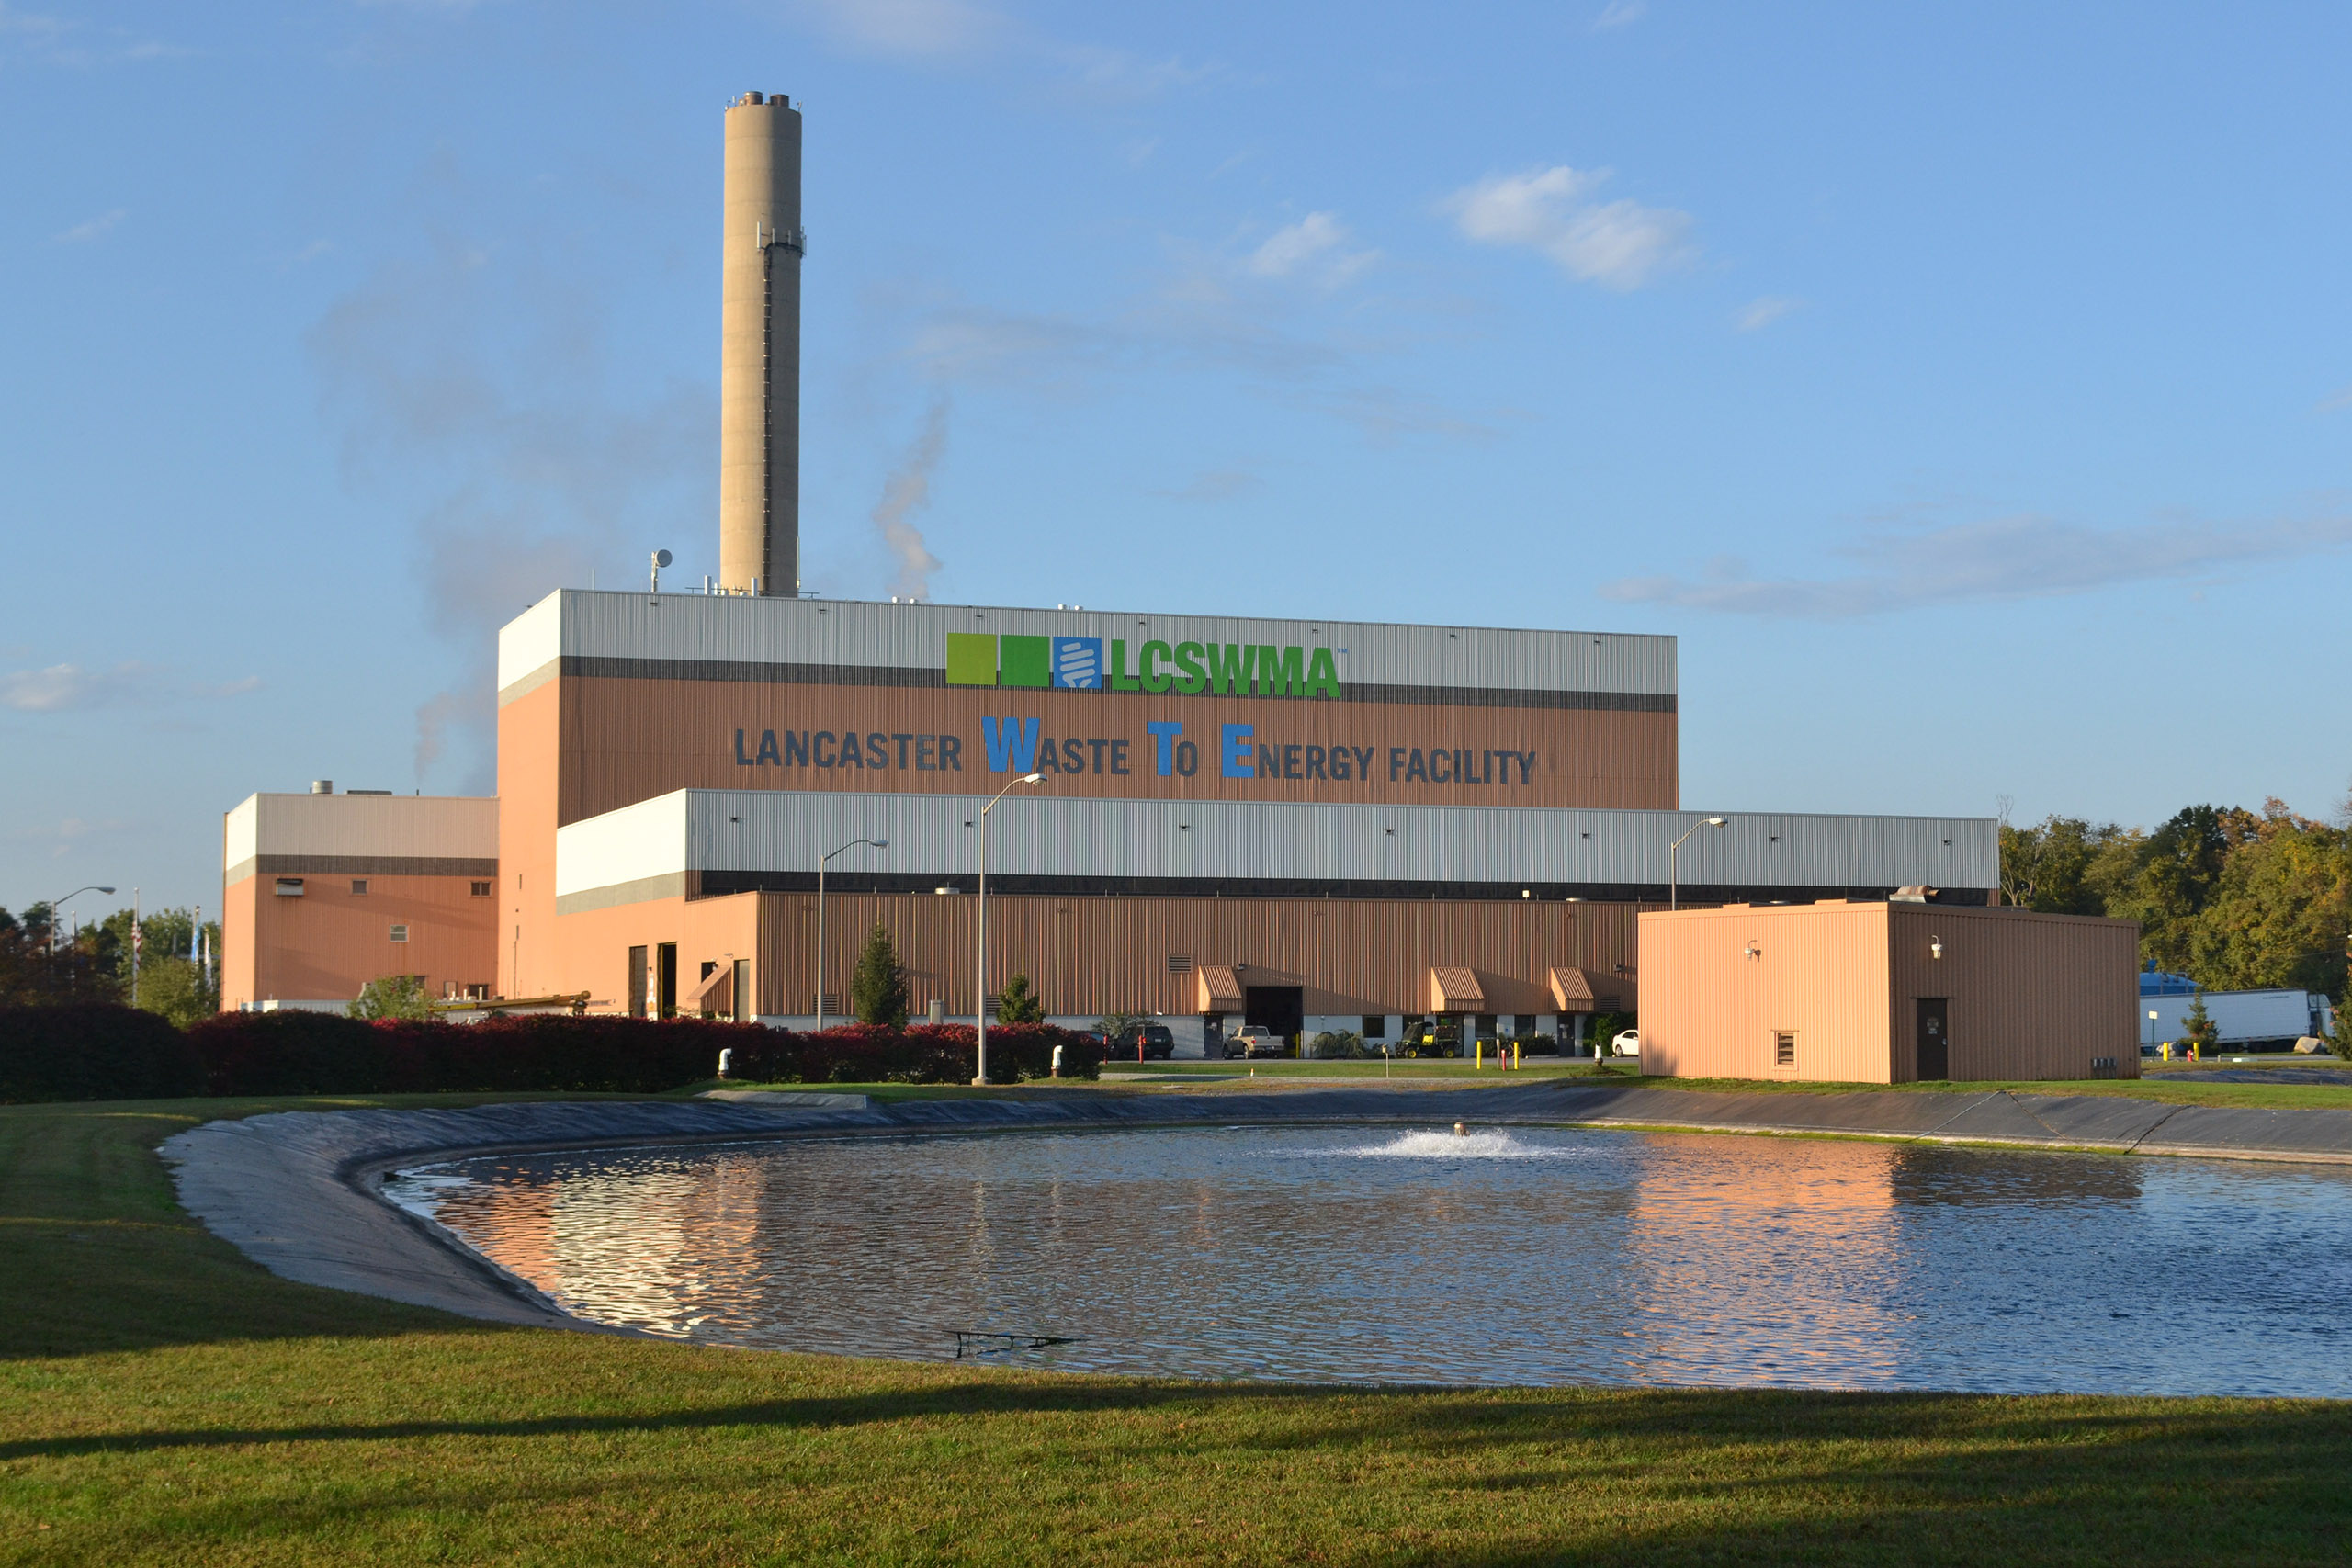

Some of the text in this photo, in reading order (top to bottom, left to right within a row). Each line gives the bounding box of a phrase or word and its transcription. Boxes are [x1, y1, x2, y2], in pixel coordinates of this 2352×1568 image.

[1111, 639, 1340, 697] LCSWMA
[736, 716, 1536, 785] LANCASTER WASTE TO ENERGY FACILITY
